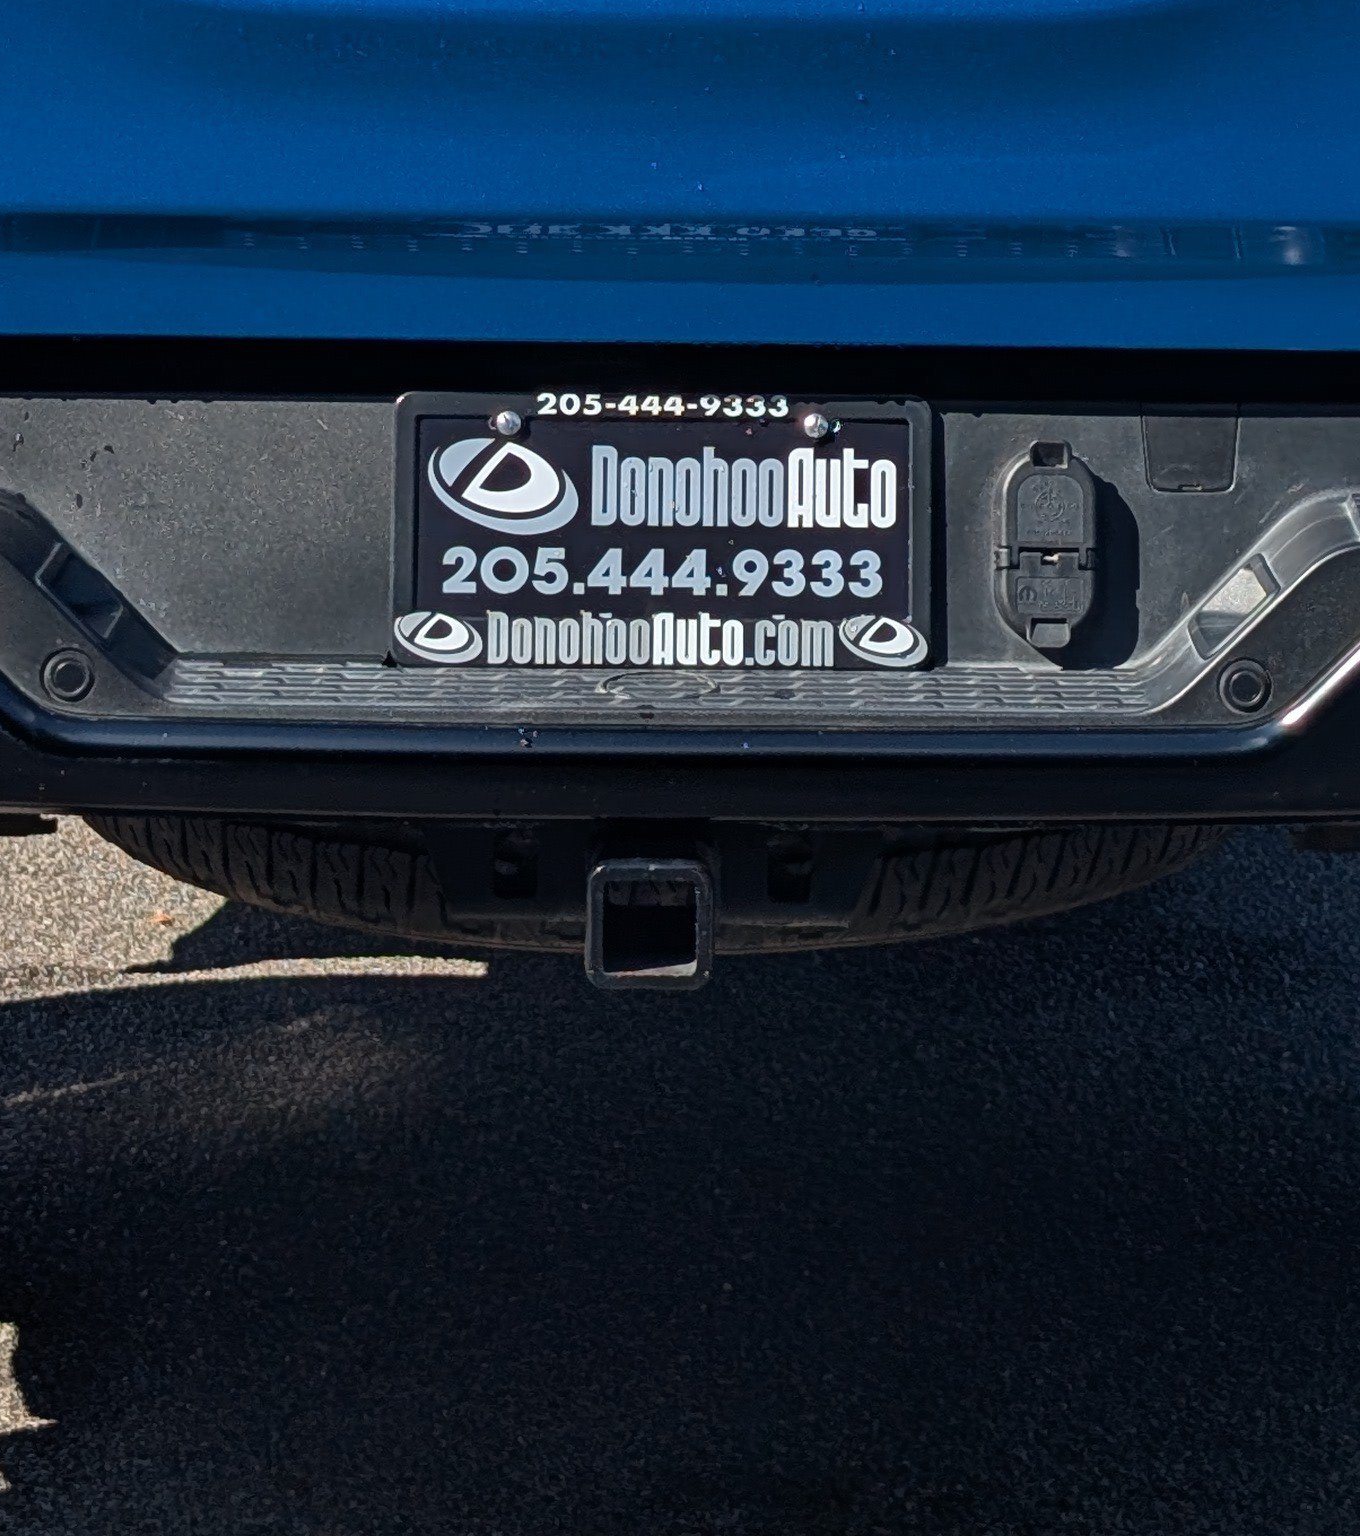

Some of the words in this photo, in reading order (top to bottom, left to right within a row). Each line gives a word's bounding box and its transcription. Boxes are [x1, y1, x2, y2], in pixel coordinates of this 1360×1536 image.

[536, 391, 790, 418] 205-444-9333
[591, 445, 897, 528] DonohooAuto
[441, 545, 883, 597] 205.444.9333
[485, 611, 834, 666] DonohooAuto.com
